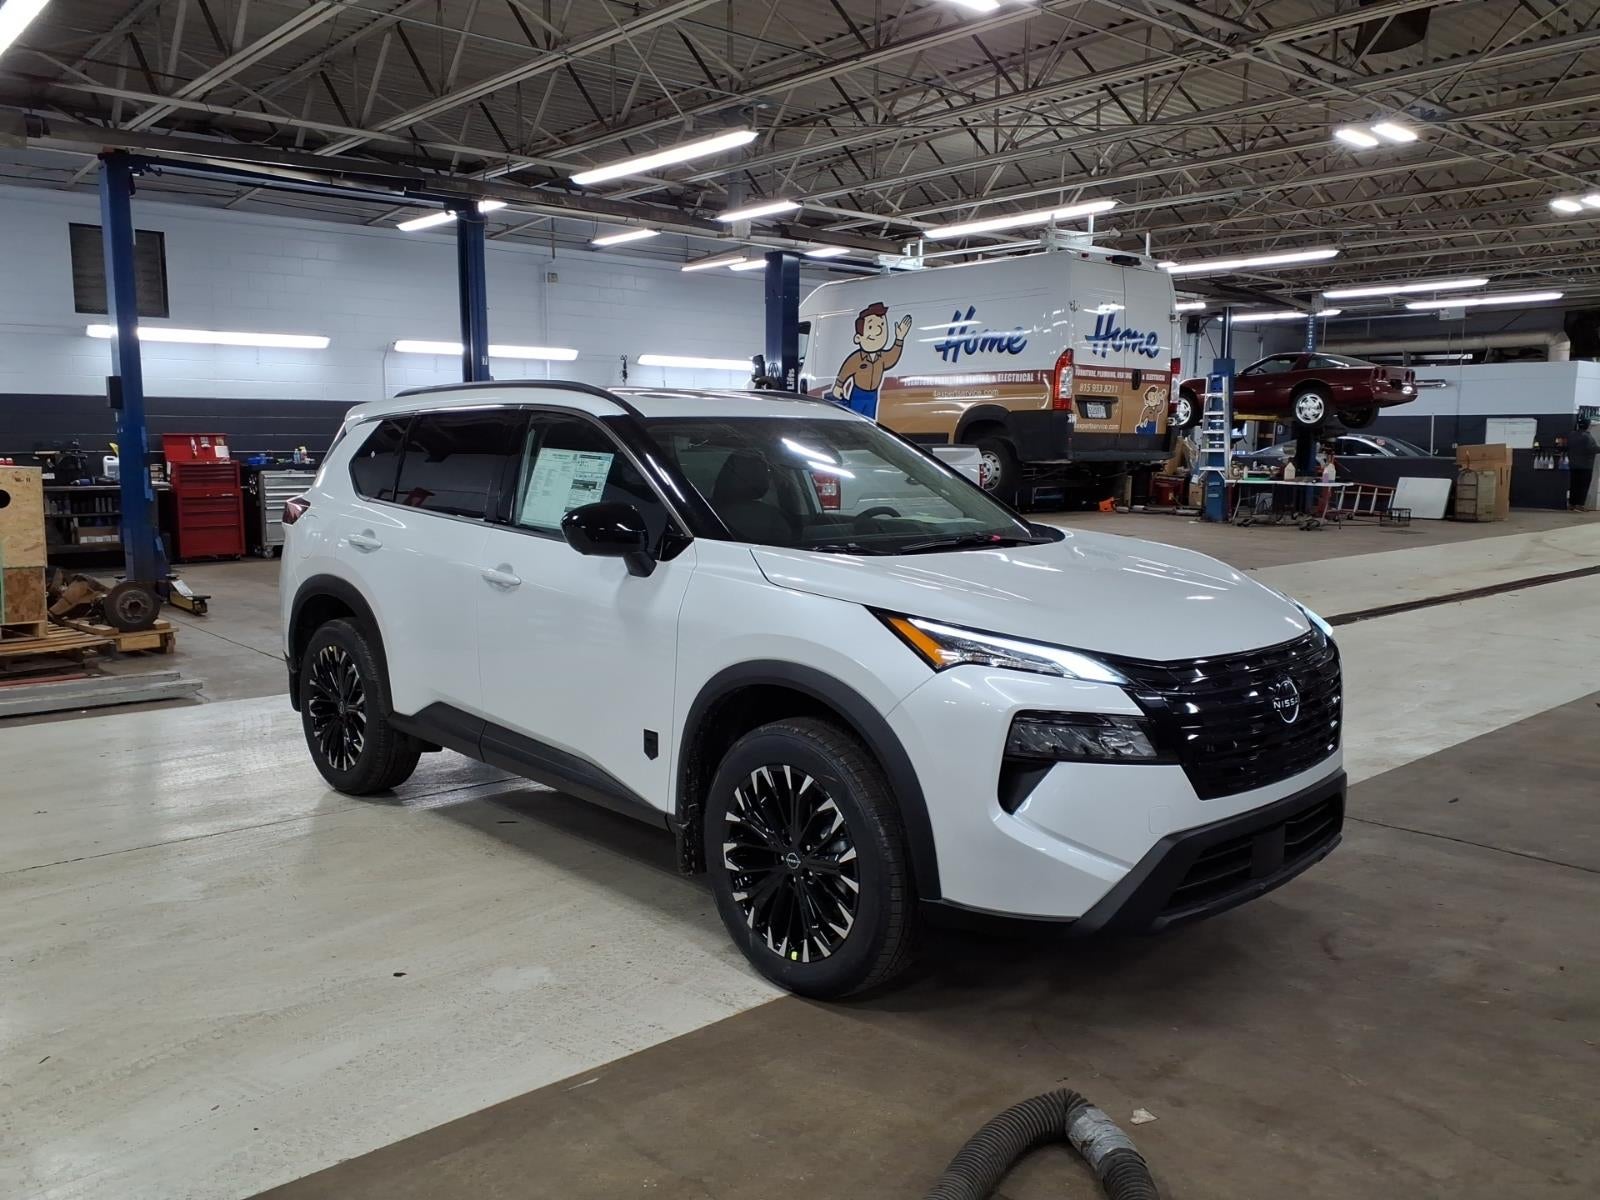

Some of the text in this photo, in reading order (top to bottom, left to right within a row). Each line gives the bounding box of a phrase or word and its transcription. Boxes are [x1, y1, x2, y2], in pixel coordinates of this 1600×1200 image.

[935, 305, 1028, 363] Home
[1085, 301, 1160, 359] Home
[998, 371, 1034, 382] ELECTRICAL
[1273, 697, 1299, 709] NISS
